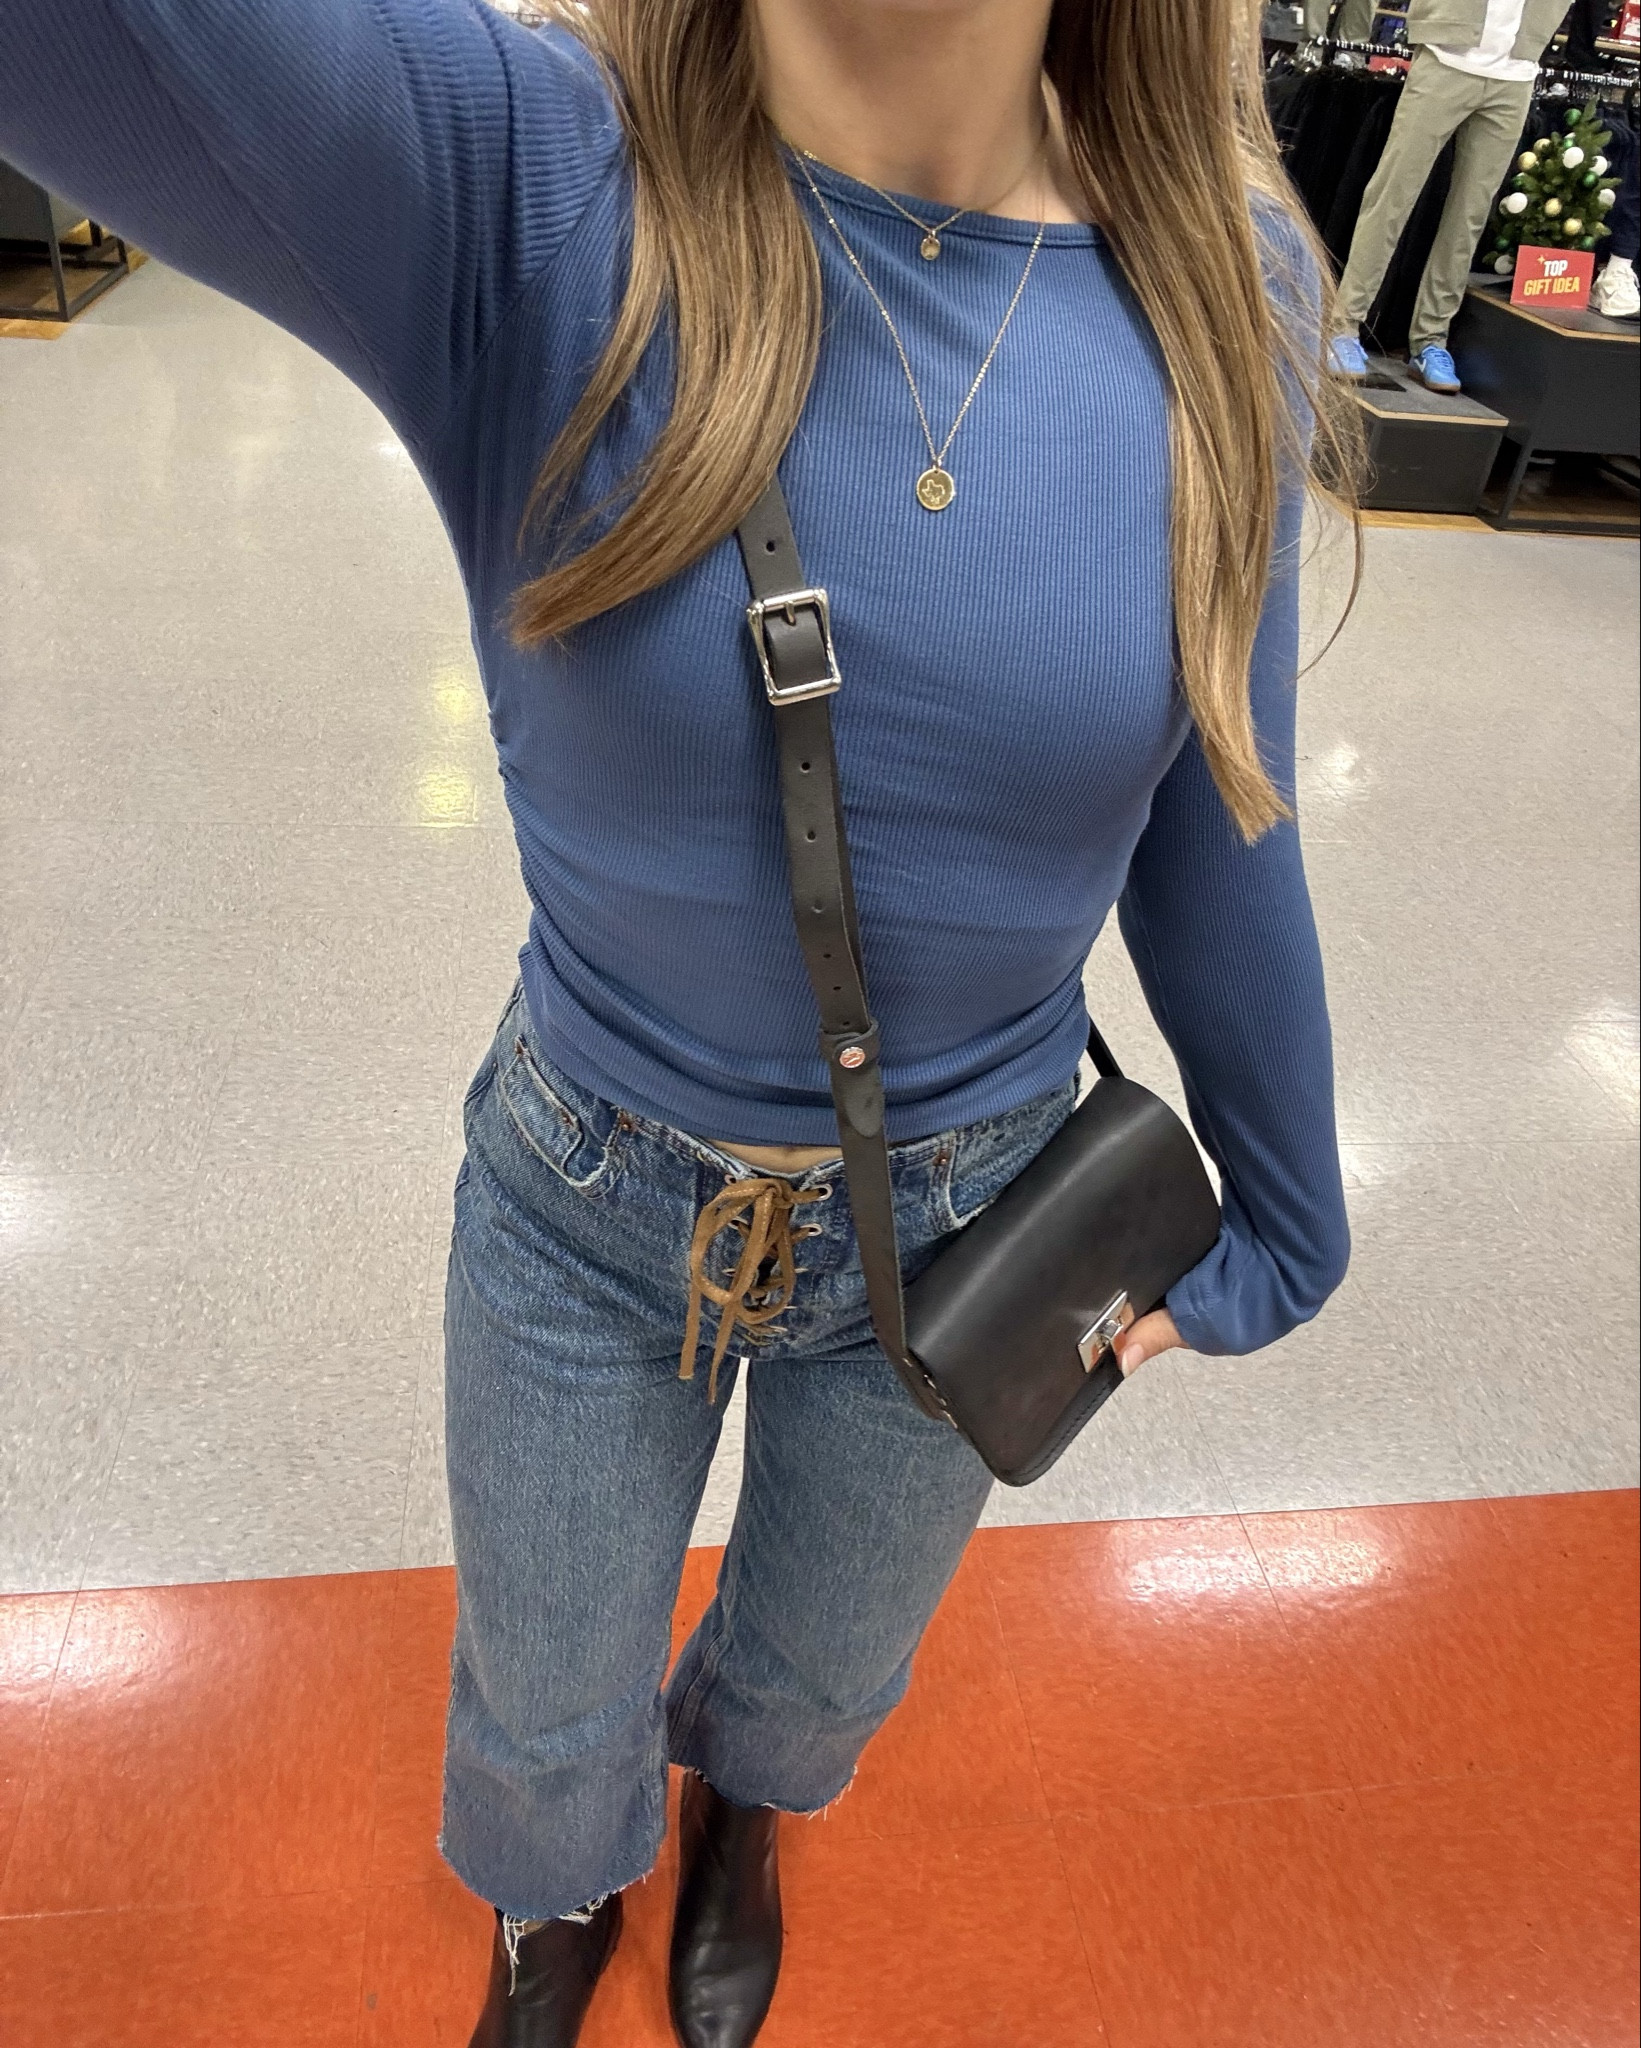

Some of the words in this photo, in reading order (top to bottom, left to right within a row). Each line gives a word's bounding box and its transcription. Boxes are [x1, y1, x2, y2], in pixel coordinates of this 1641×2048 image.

[1543, 259, 1568, 277] TOP
[1523, 279, 1552, 296] GIFT
[1552, 276, 1580, 294] IDEA
